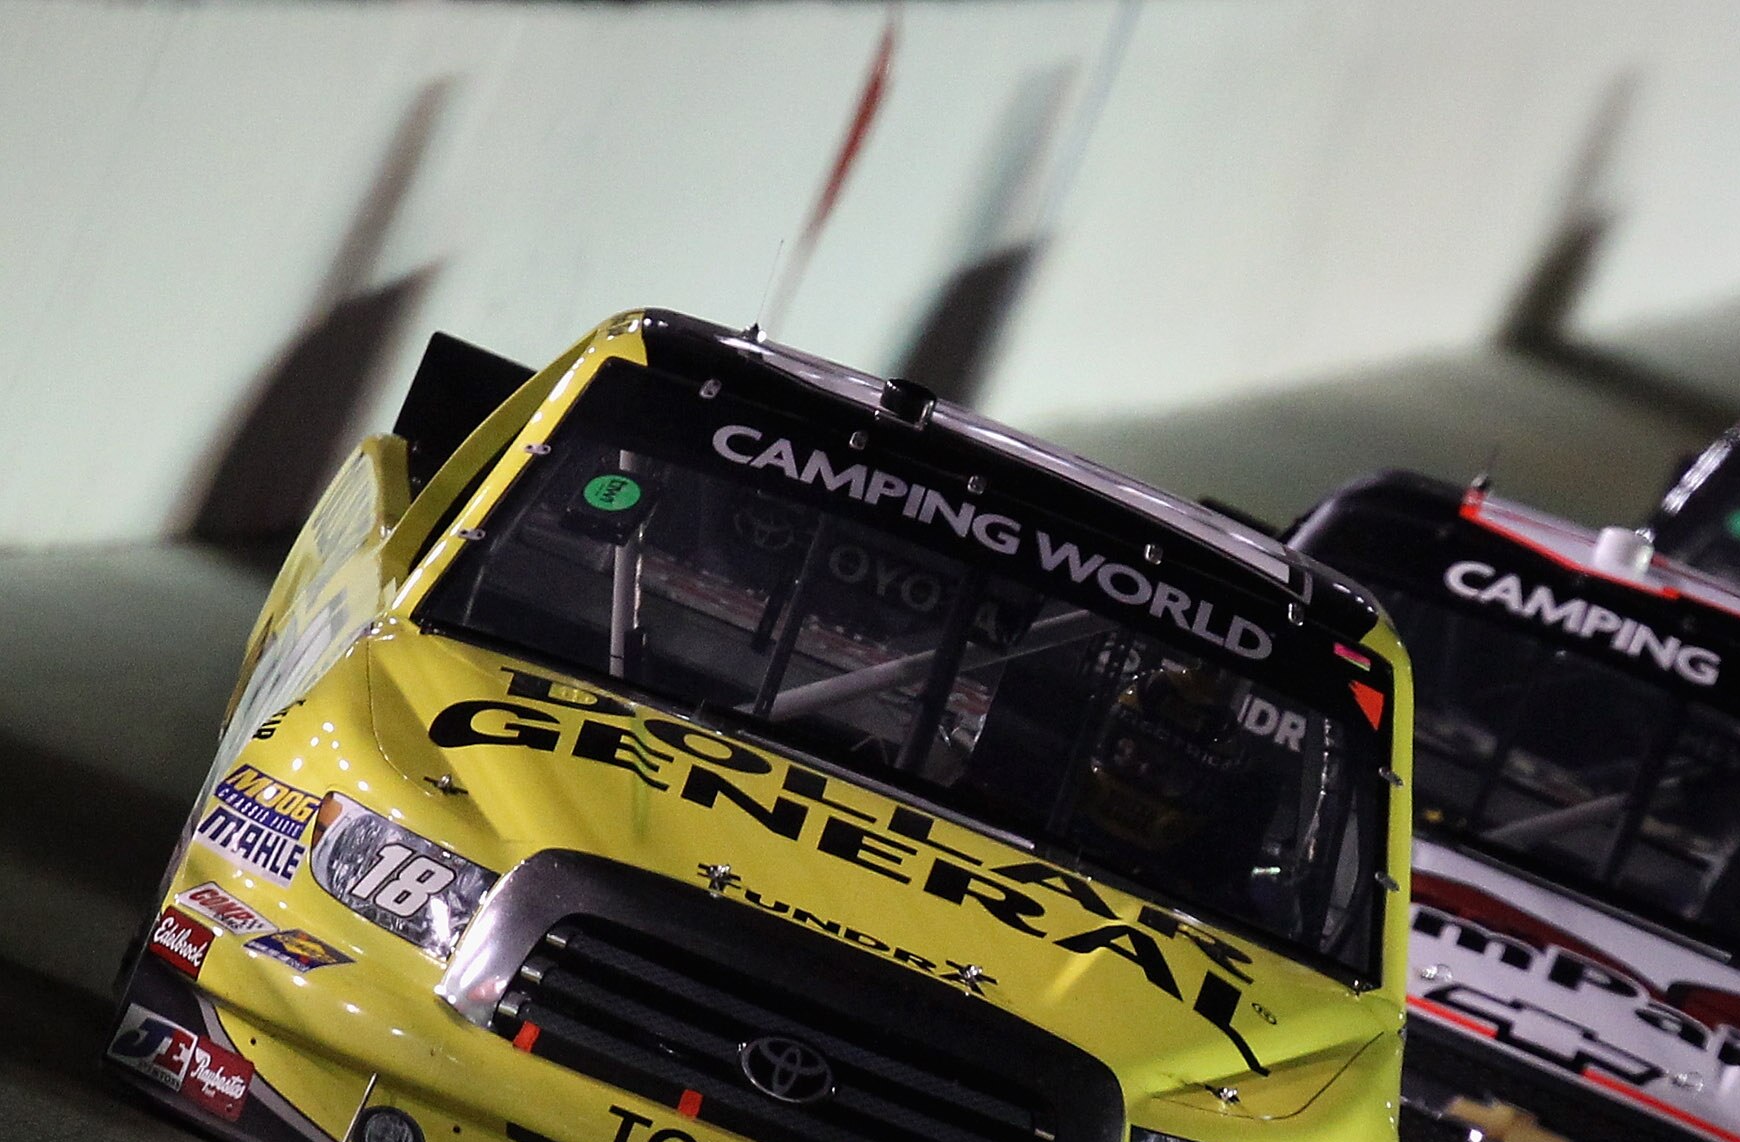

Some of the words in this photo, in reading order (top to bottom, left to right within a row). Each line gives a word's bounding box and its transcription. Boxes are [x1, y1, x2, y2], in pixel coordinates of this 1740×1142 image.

[712, 424, 1021, 556] CAMPING
[1036, 530, 1273, 660] WORLD
[1443, 560, 1720, 686] CAMPING
[198, 805, 306, 881] MAHLE
[223, 768, 321, 824] MOOG
[500, 666, 1255, 984] DOLLAR
[153, 916, 208, 968] Edelbrock
[351, 843, 458, 919] 18
[428, 699, 1272, 1077] GENERAL
[697, 862, 998, 997] TUNDRA
